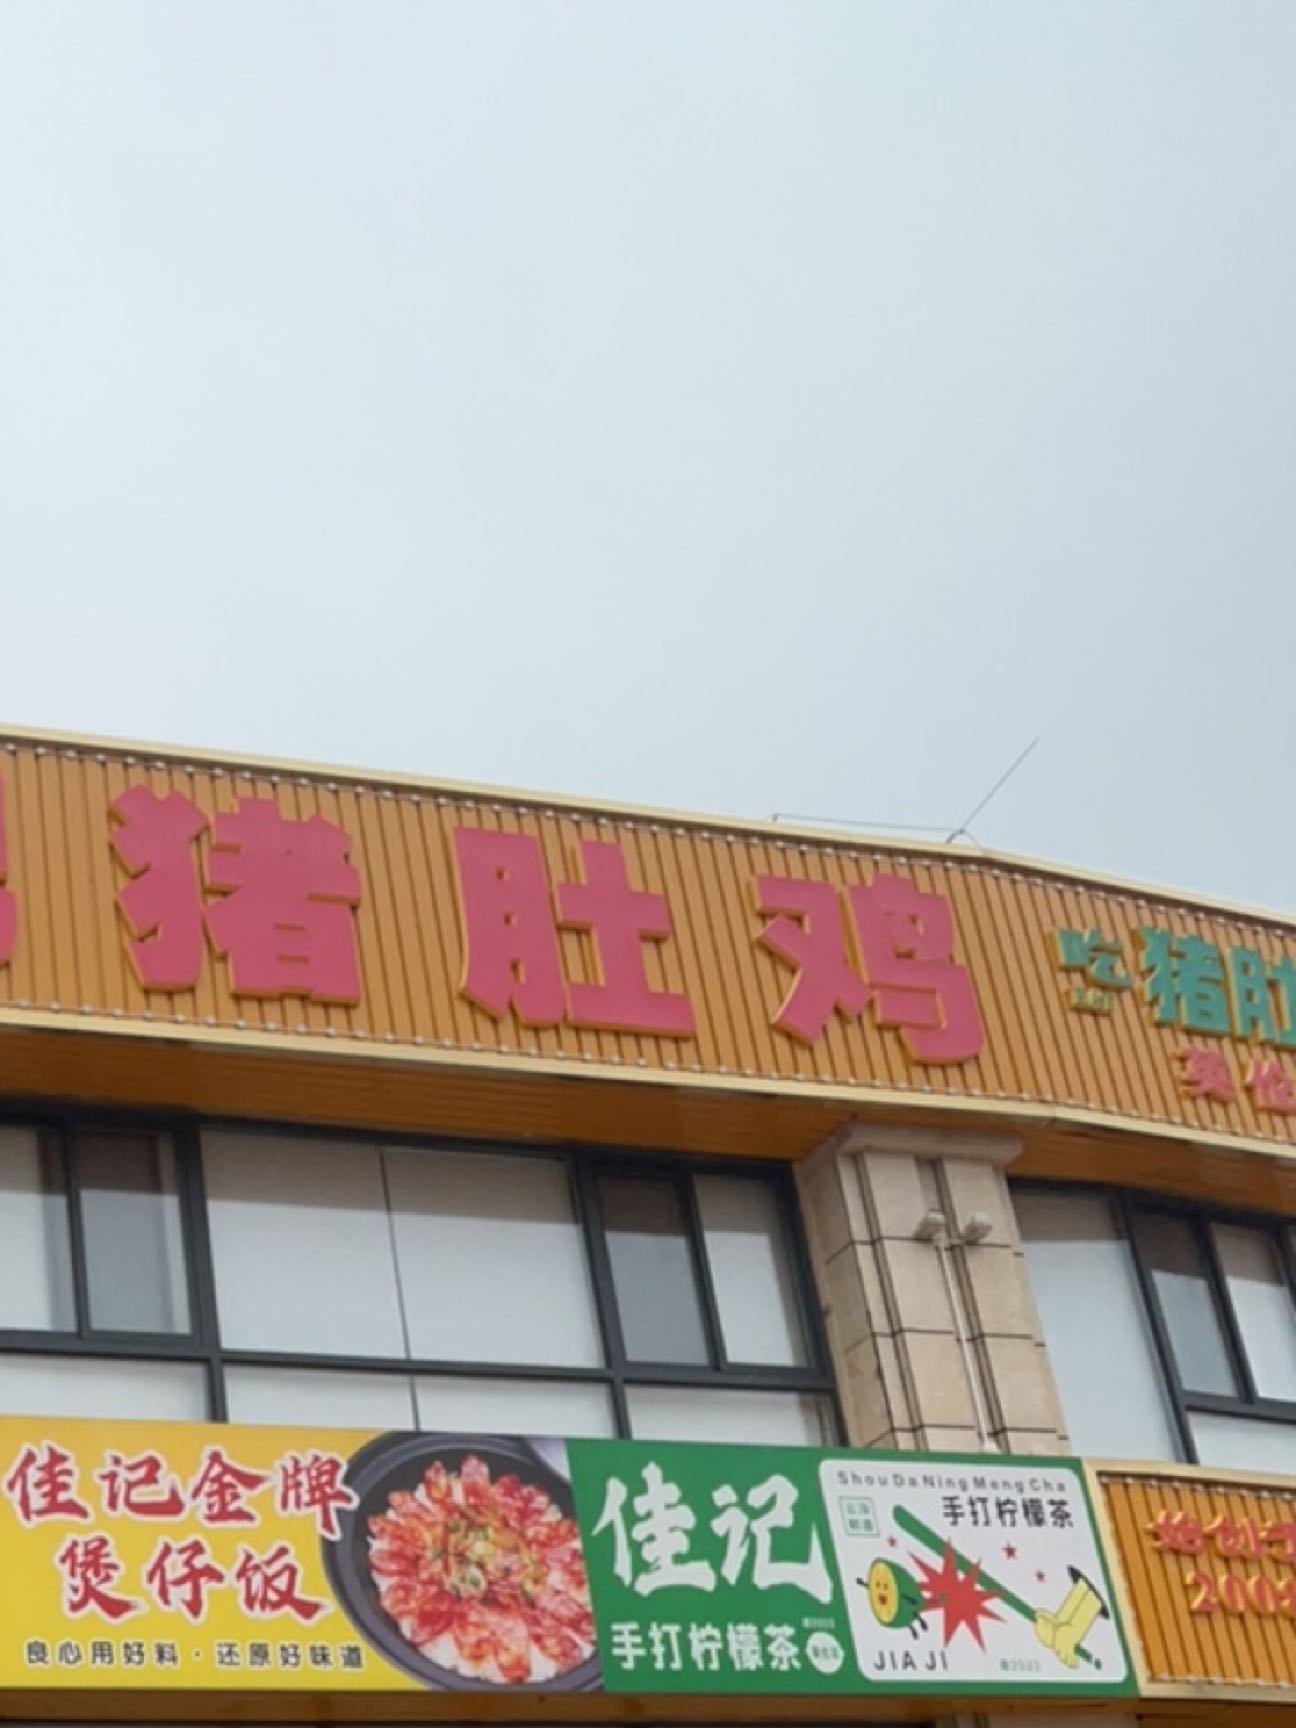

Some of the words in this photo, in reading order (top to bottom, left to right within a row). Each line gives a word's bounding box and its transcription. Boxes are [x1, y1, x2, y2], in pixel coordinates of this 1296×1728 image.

[4, 1440, 360, 1541] 佳记金牌
[837, 1470, 888, 1487] Shou
[942, 1496, 1074, 1528] 手打柠檬茶
[592, 1462, 833, 1604] 佳记
[55, 1535, 332, 1627] 煲仔饭
[610, 1620, 803, 1674] 手打柠檬茶
